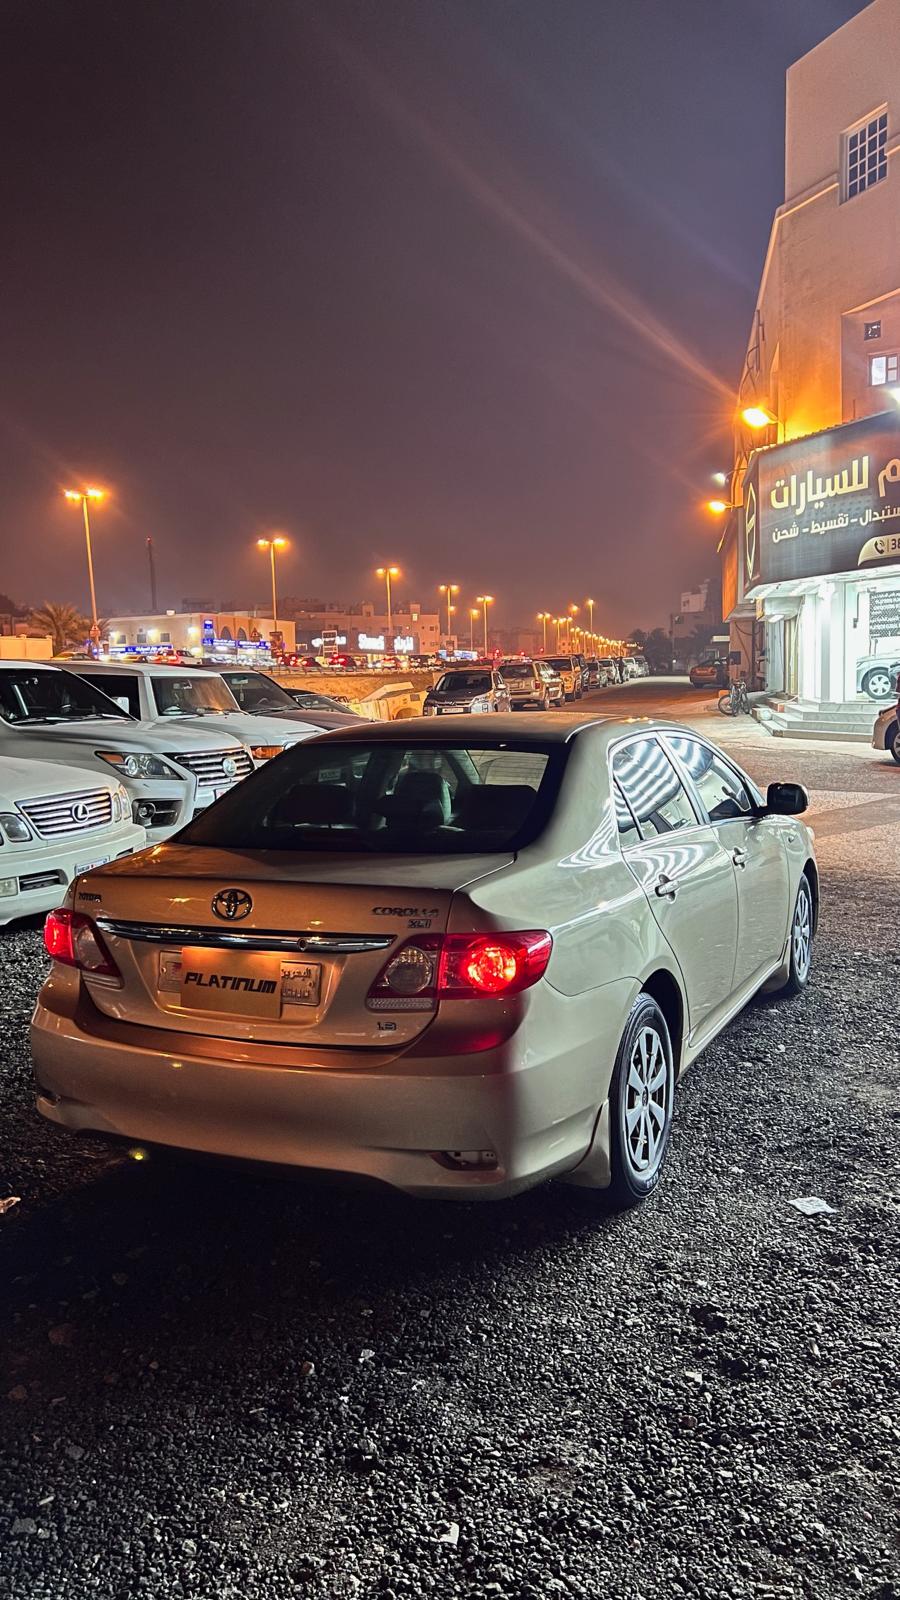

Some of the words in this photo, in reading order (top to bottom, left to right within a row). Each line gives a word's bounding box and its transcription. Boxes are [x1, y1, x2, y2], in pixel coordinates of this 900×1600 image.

[770, 456, 869, 516] للسيارات
[772, 521, 799, 543] شحن
[810, 513, 849, 535] تقسيط
[184, 971, 278, 994] PLATINUM
